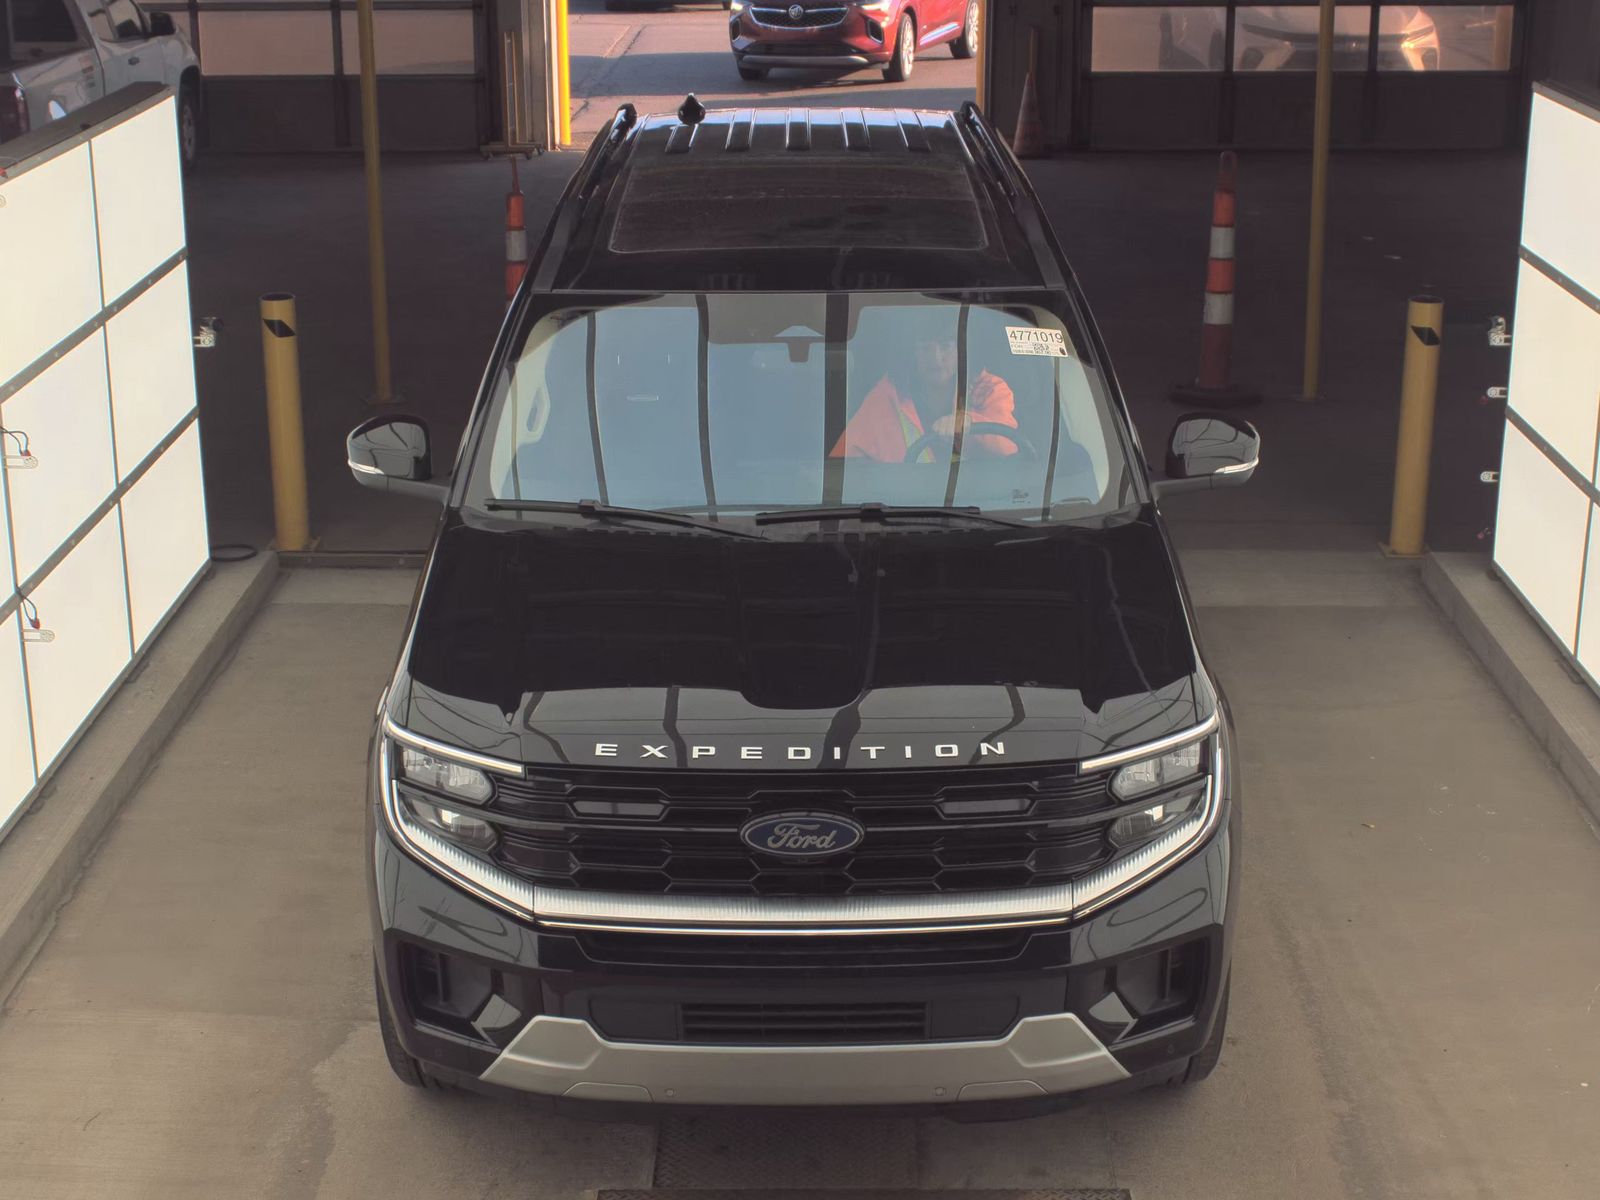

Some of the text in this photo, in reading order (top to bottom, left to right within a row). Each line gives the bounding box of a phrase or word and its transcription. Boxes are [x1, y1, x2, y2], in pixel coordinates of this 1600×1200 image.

[1010, 330, 1064, 344] 4771019
[595, 742, 1006, 760] EXPEDITION
[767, 822, 838, 849] Ford
